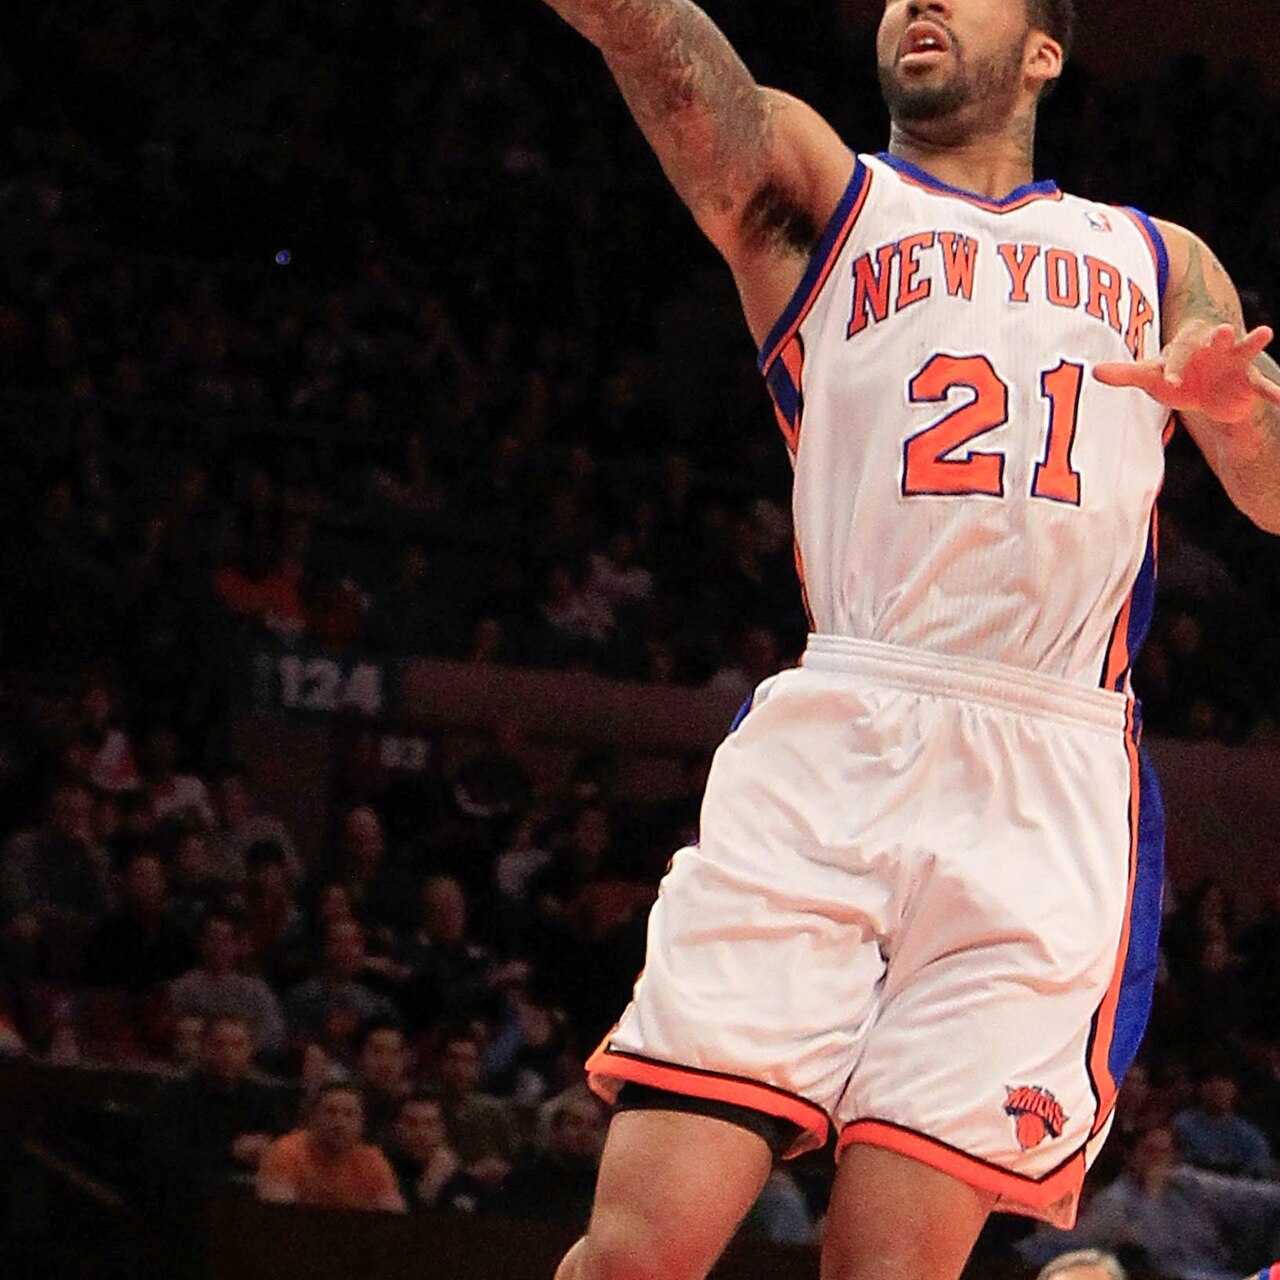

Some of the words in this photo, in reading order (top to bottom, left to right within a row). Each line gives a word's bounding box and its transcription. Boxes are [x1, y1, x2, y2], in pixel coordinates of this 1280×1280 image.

[846, 230, 978, 341] NEW
[998, 242, 1155, 361] YORK
[902, 353, 1084, 506] 21
